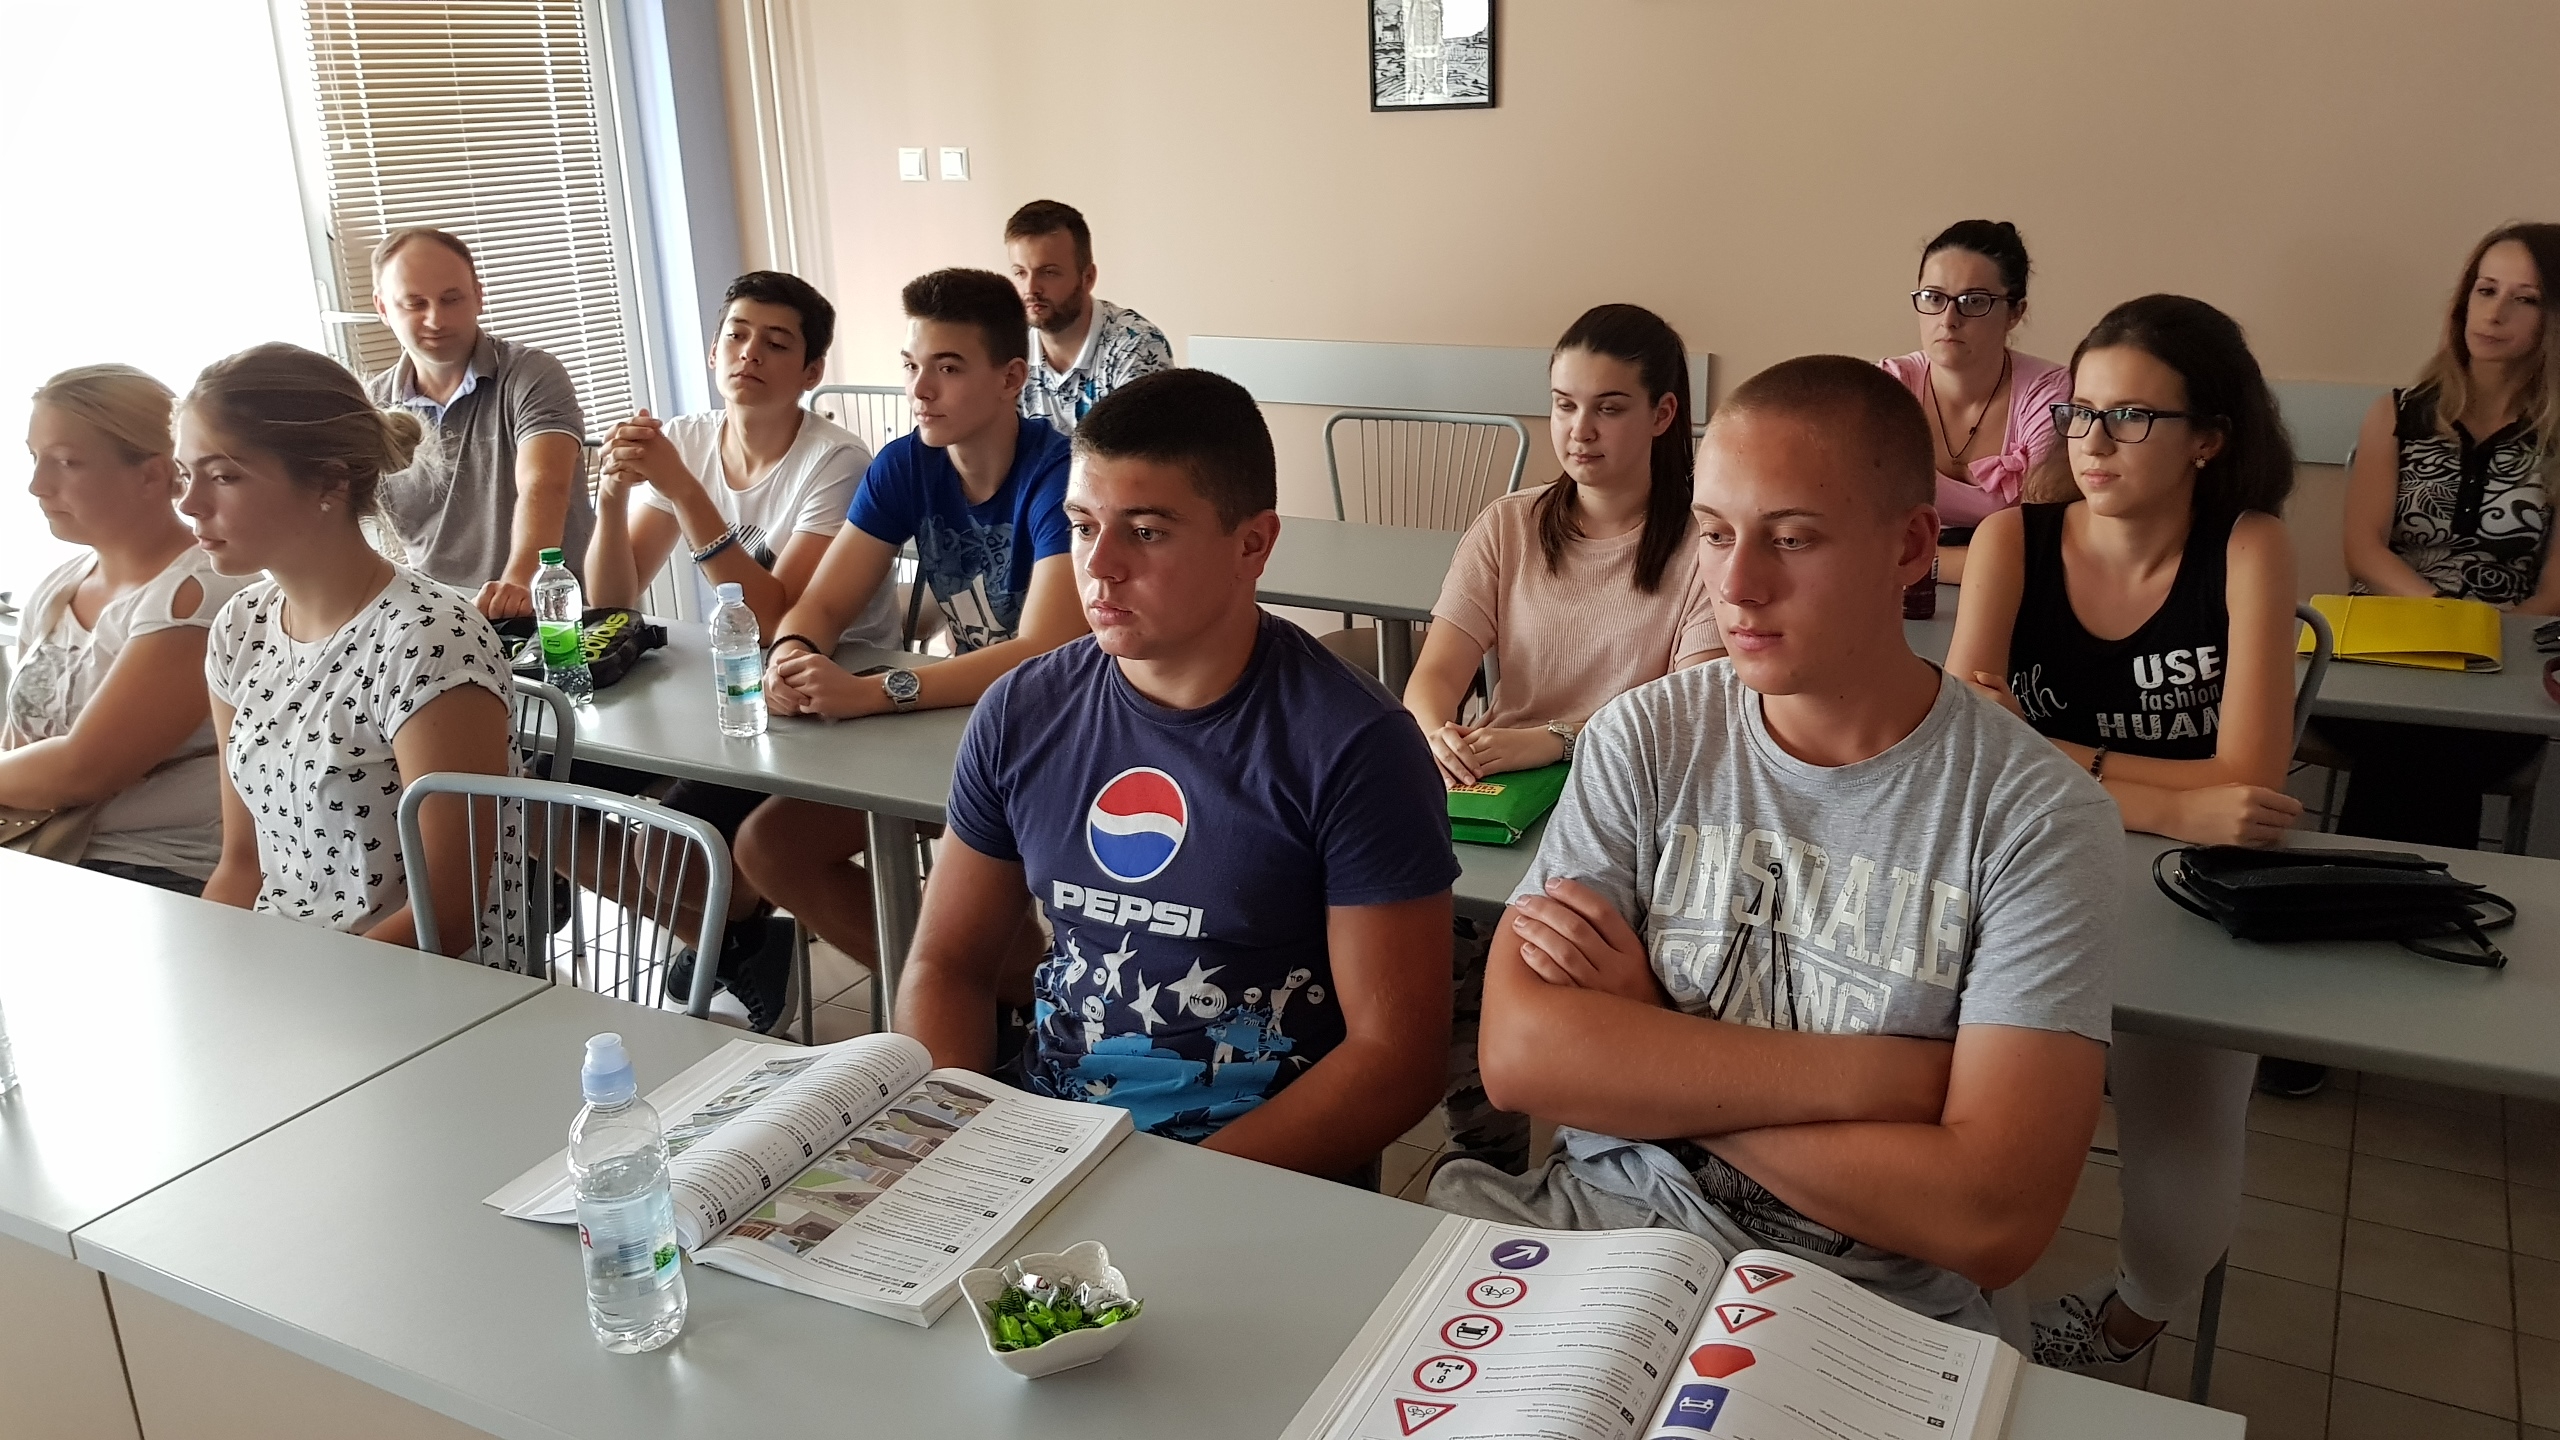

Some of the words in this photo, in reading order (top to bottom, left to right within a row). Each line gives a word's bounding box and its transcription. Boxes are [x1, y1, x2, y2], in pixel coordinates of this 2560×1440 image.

[2133, 645, 2221, 689] USE
[2139, 682, 2220, 711] fashion
[1052, 880, 1205, 938] PEPSI
[1436, 1375, 1446, 1384] 8
